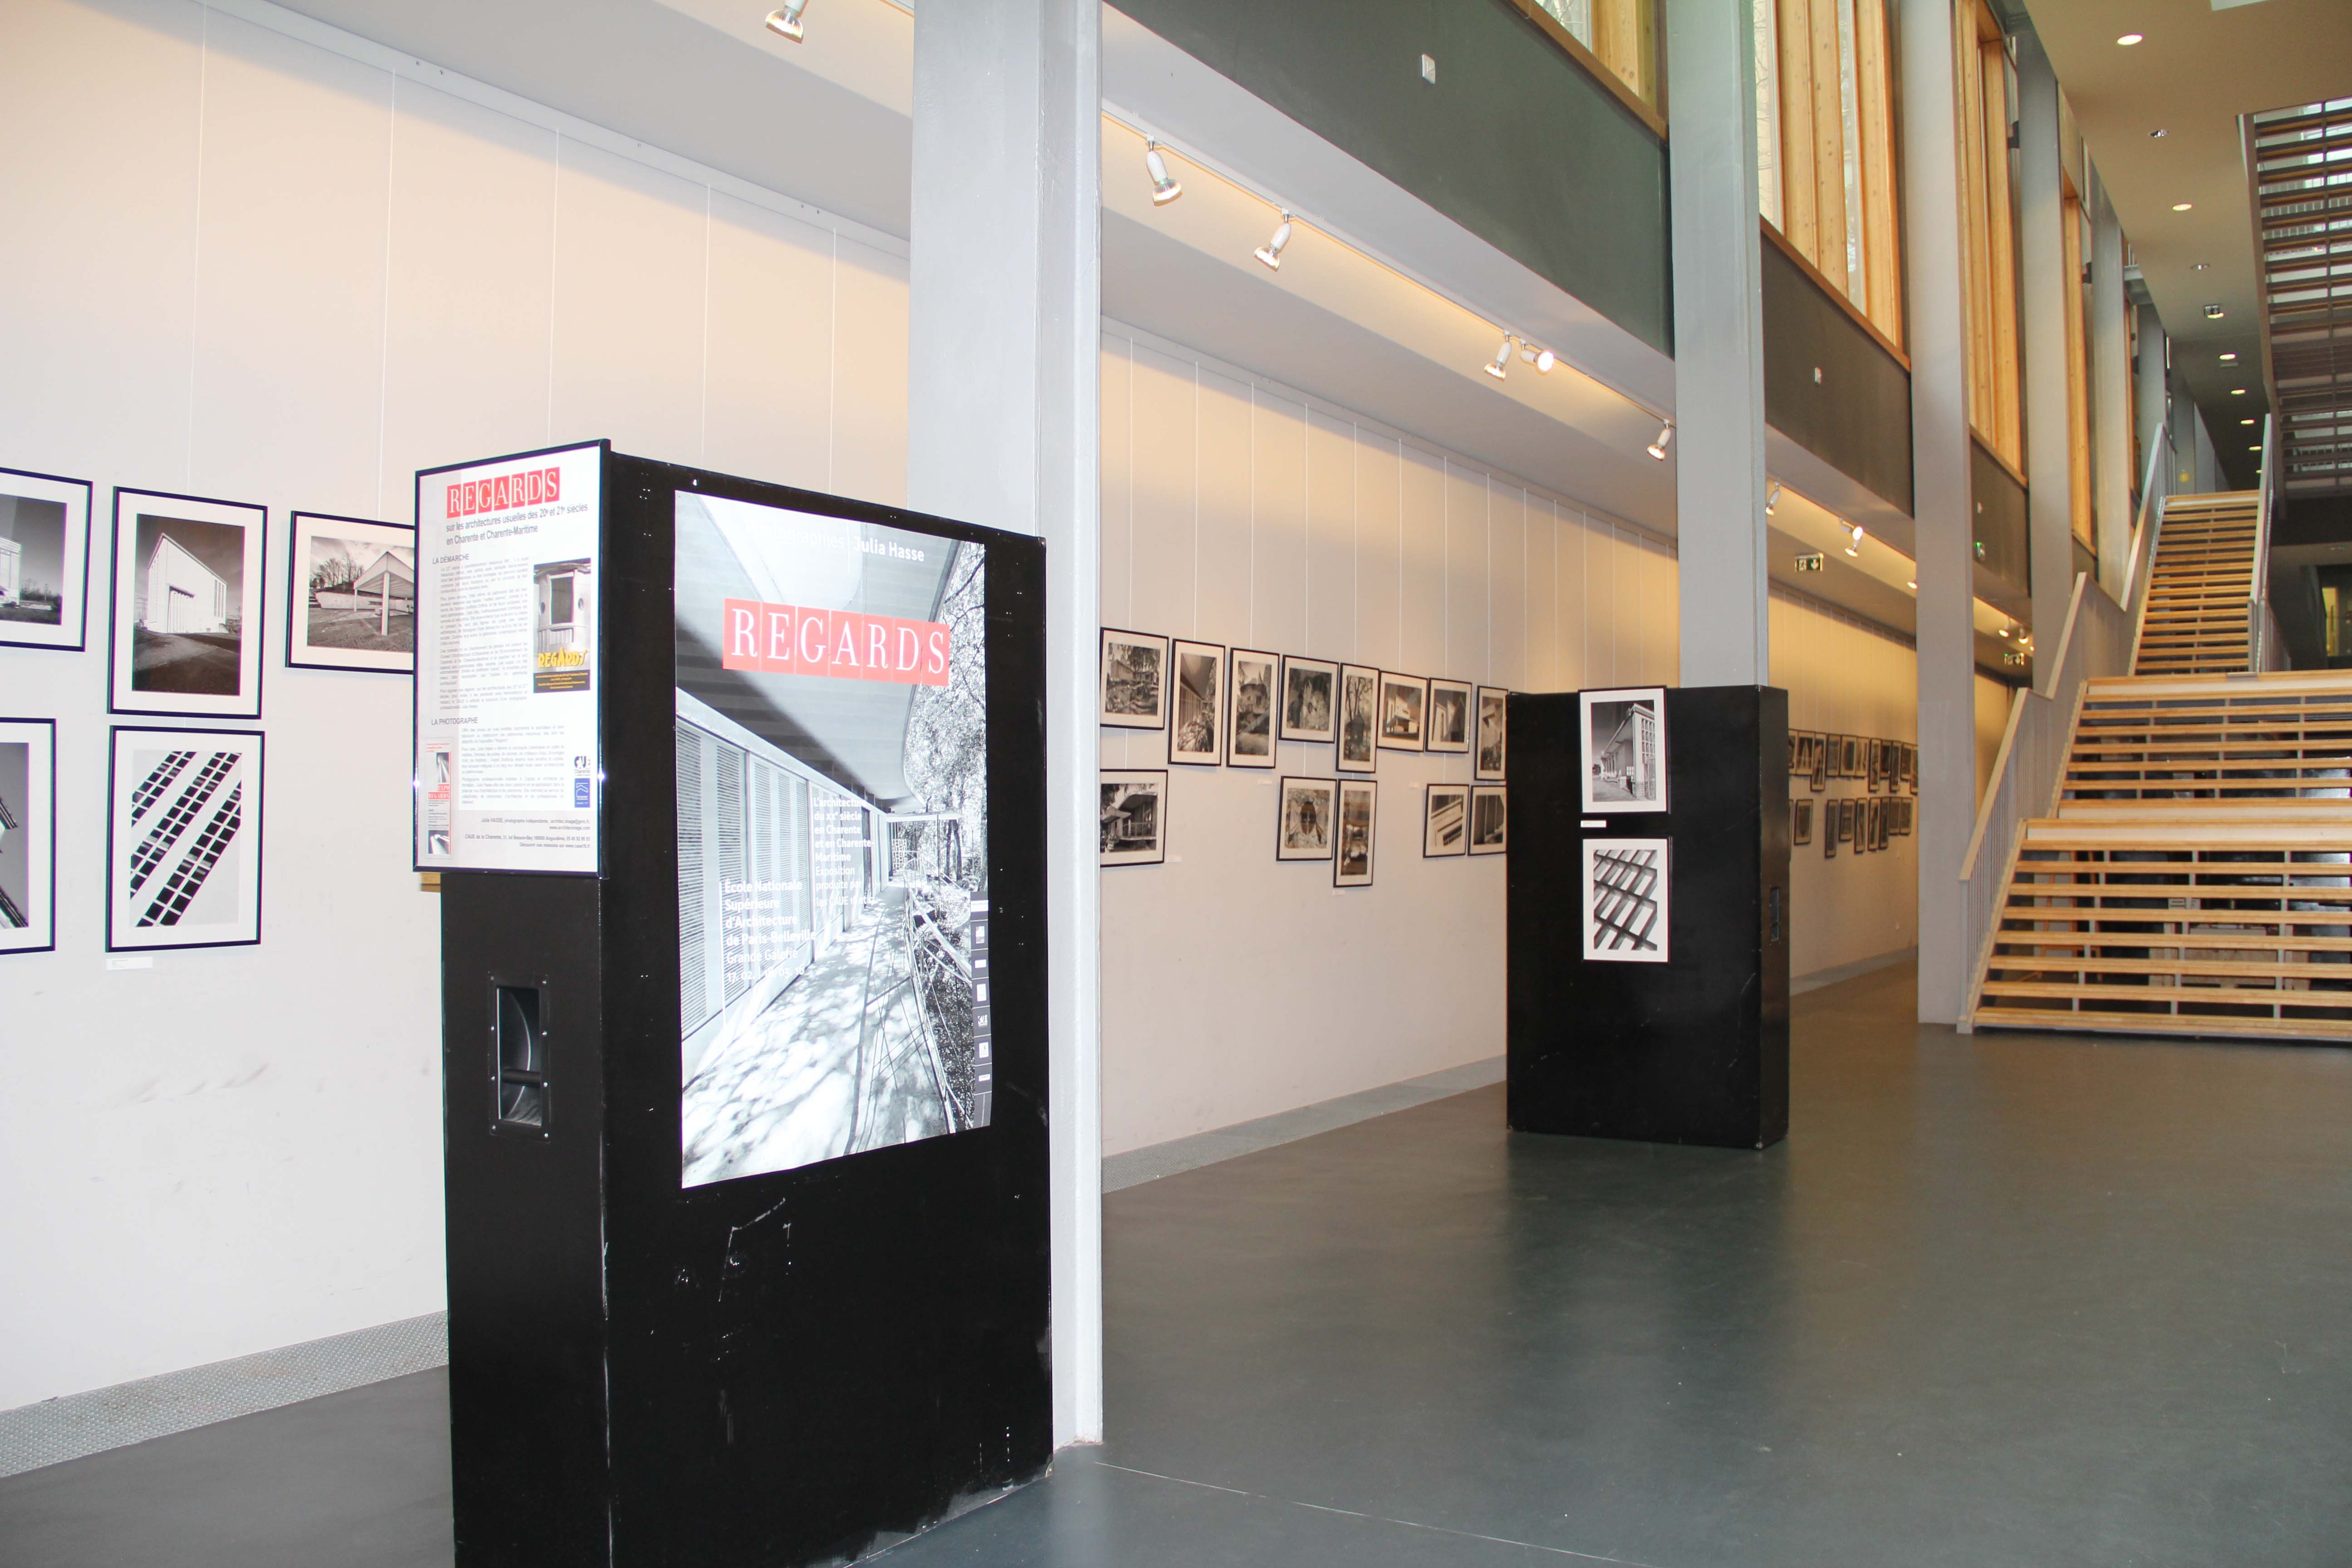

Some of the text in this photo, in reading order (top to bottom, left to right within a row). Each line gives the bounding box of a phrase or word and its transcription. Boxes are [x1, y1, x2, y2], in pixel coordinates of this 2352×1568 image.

[449, 470, 557, 514] REGARDS
[446, 524, 455, 533] sur
[465, 515, 501, 529] architectures
[502, 512, 526, 524] usuelles
[527, 510, 538, 519] des
[549, 507, 555, 516] et
[567, 502, 588, 513] siècles
[446, 524, 538, 545] en Charente et Charente-Maritime
[853, 535, 886, 556] Julia
[889, 541, 925, 562] Hasse
[731, 608, 944, 674] REGARDS
[538, 646, 588, 668] REGARDS
[813, 797, 867, 807] L'architecture
[814, 811, 824, 820] du
[840, 811, 862, 820] siècle
[826, 824, 861, 834] Charente
[814, 839, 824, 848] et
[825, 840, 835, 848] en
[815, 852, 851, 862] Maritime
[815, 866, 855, 877] Exposition
[725, 878, 803, 893] École Nationale
[816, 880, 862, 891] produite par
[725, 898, 780, 913] Supérieure
[816, 897, 828, 906] les
[829, 896, 849, 906] CAUE
[725, 916, 798, 929] d'Architecture
[726, 928, 816, 946] de Paris-Belleville
[726, 947, 798, 964] Grande Galerie
